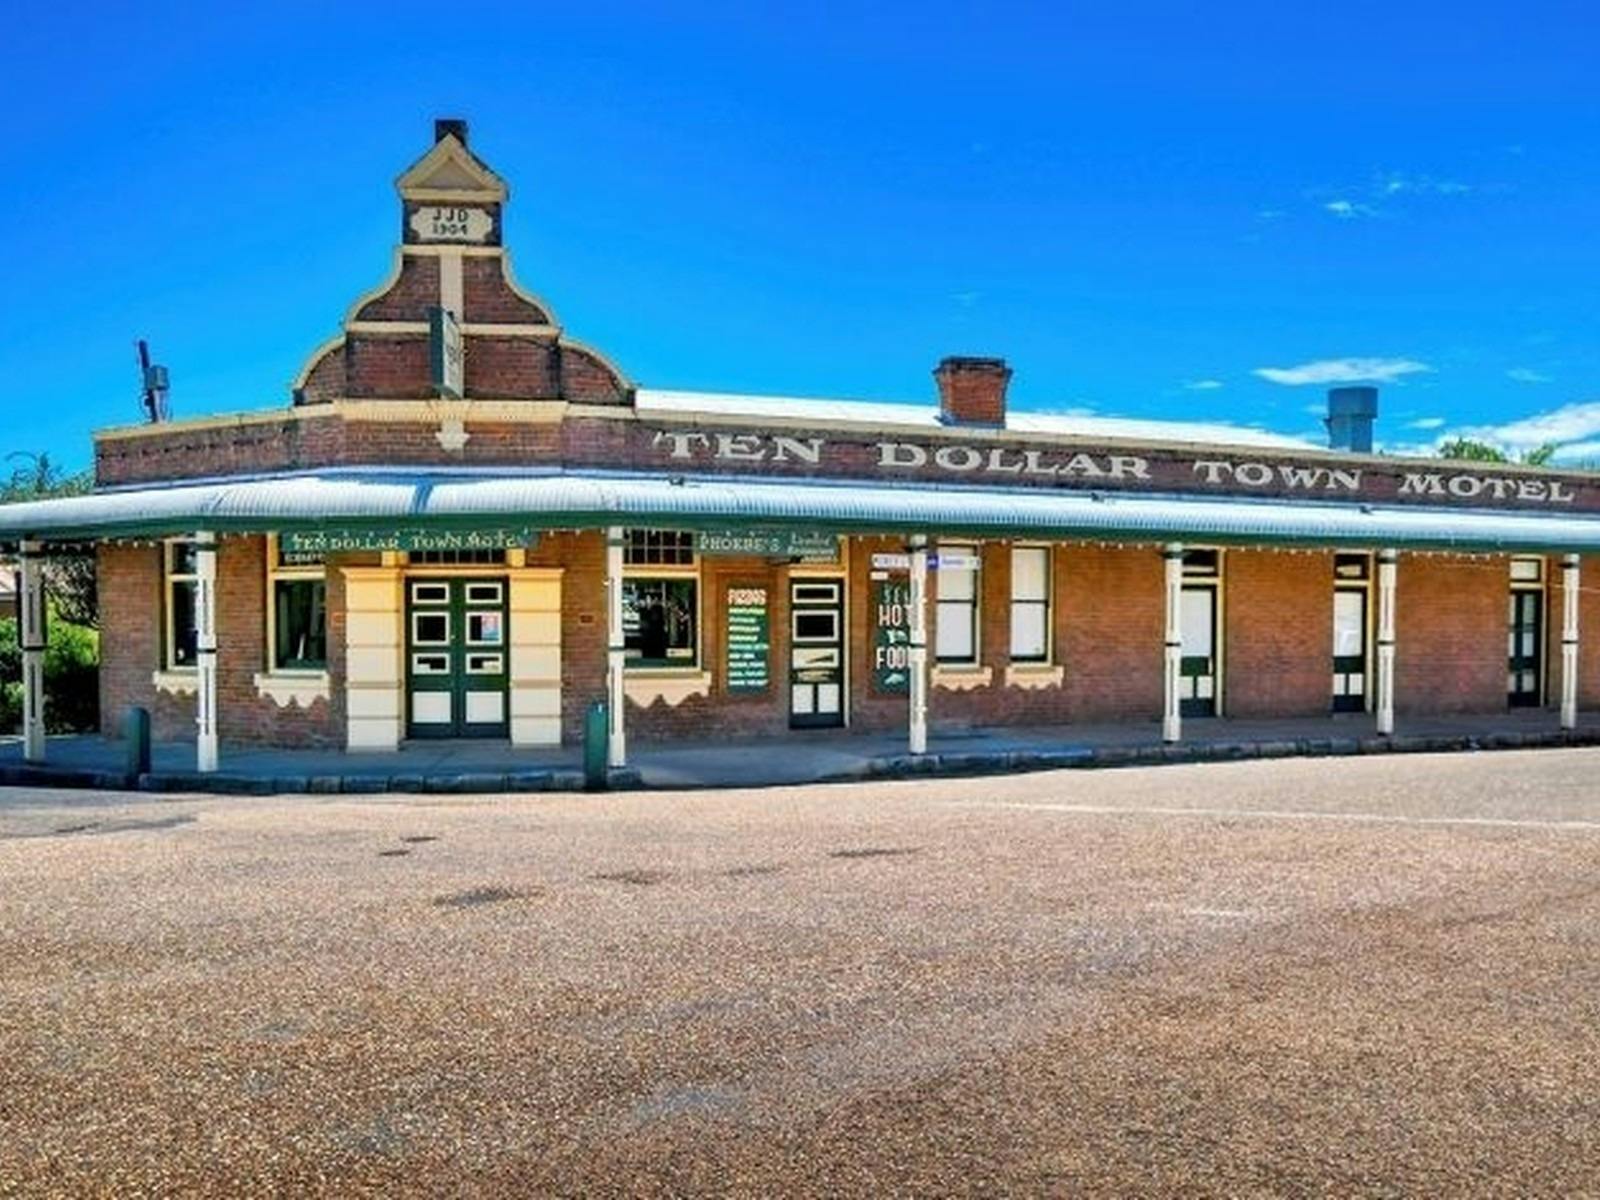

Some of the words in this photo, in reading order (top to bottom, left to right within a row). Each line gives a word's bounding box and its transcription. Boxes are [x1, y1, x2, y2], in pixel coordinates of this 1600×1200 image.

[652, 431, 825, 463] TEN
[876, 442, 1152, 479] DOLLAR
[1192, 460, 1362, 490] TOWN
[1401, 473, 1575, 502] MOTEL
[292, 536, 327, 549] TEN
[331, 537, 399, 549] DOLLAR
[411, 536, 461, 549] TOWN
